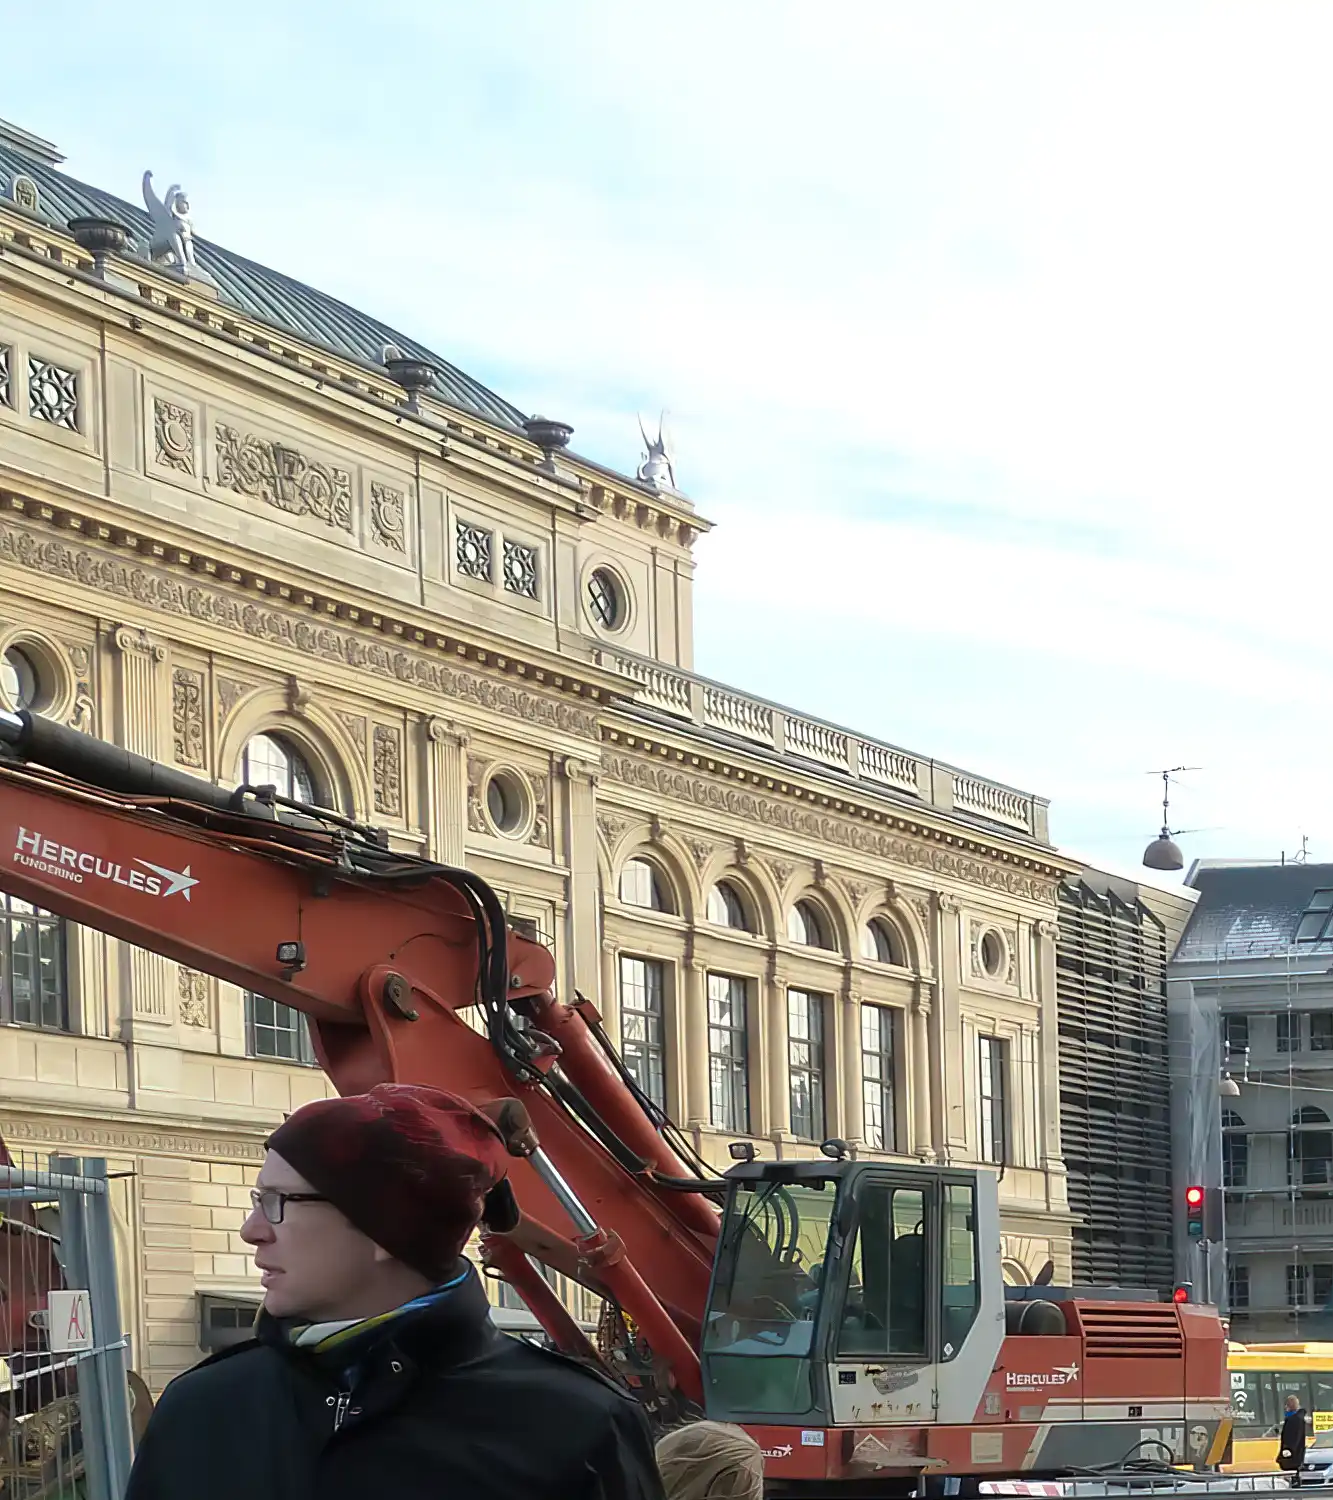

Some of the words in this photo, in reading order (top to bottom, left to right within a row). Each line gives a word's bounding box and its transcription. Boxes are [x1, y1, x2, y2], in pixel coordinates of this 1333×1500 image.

[13, 852, 84, 884] FUNDERING
[16, 826, 162, 896] HERCULES
[1006, 1372, 1066, 1385] HERCULES
